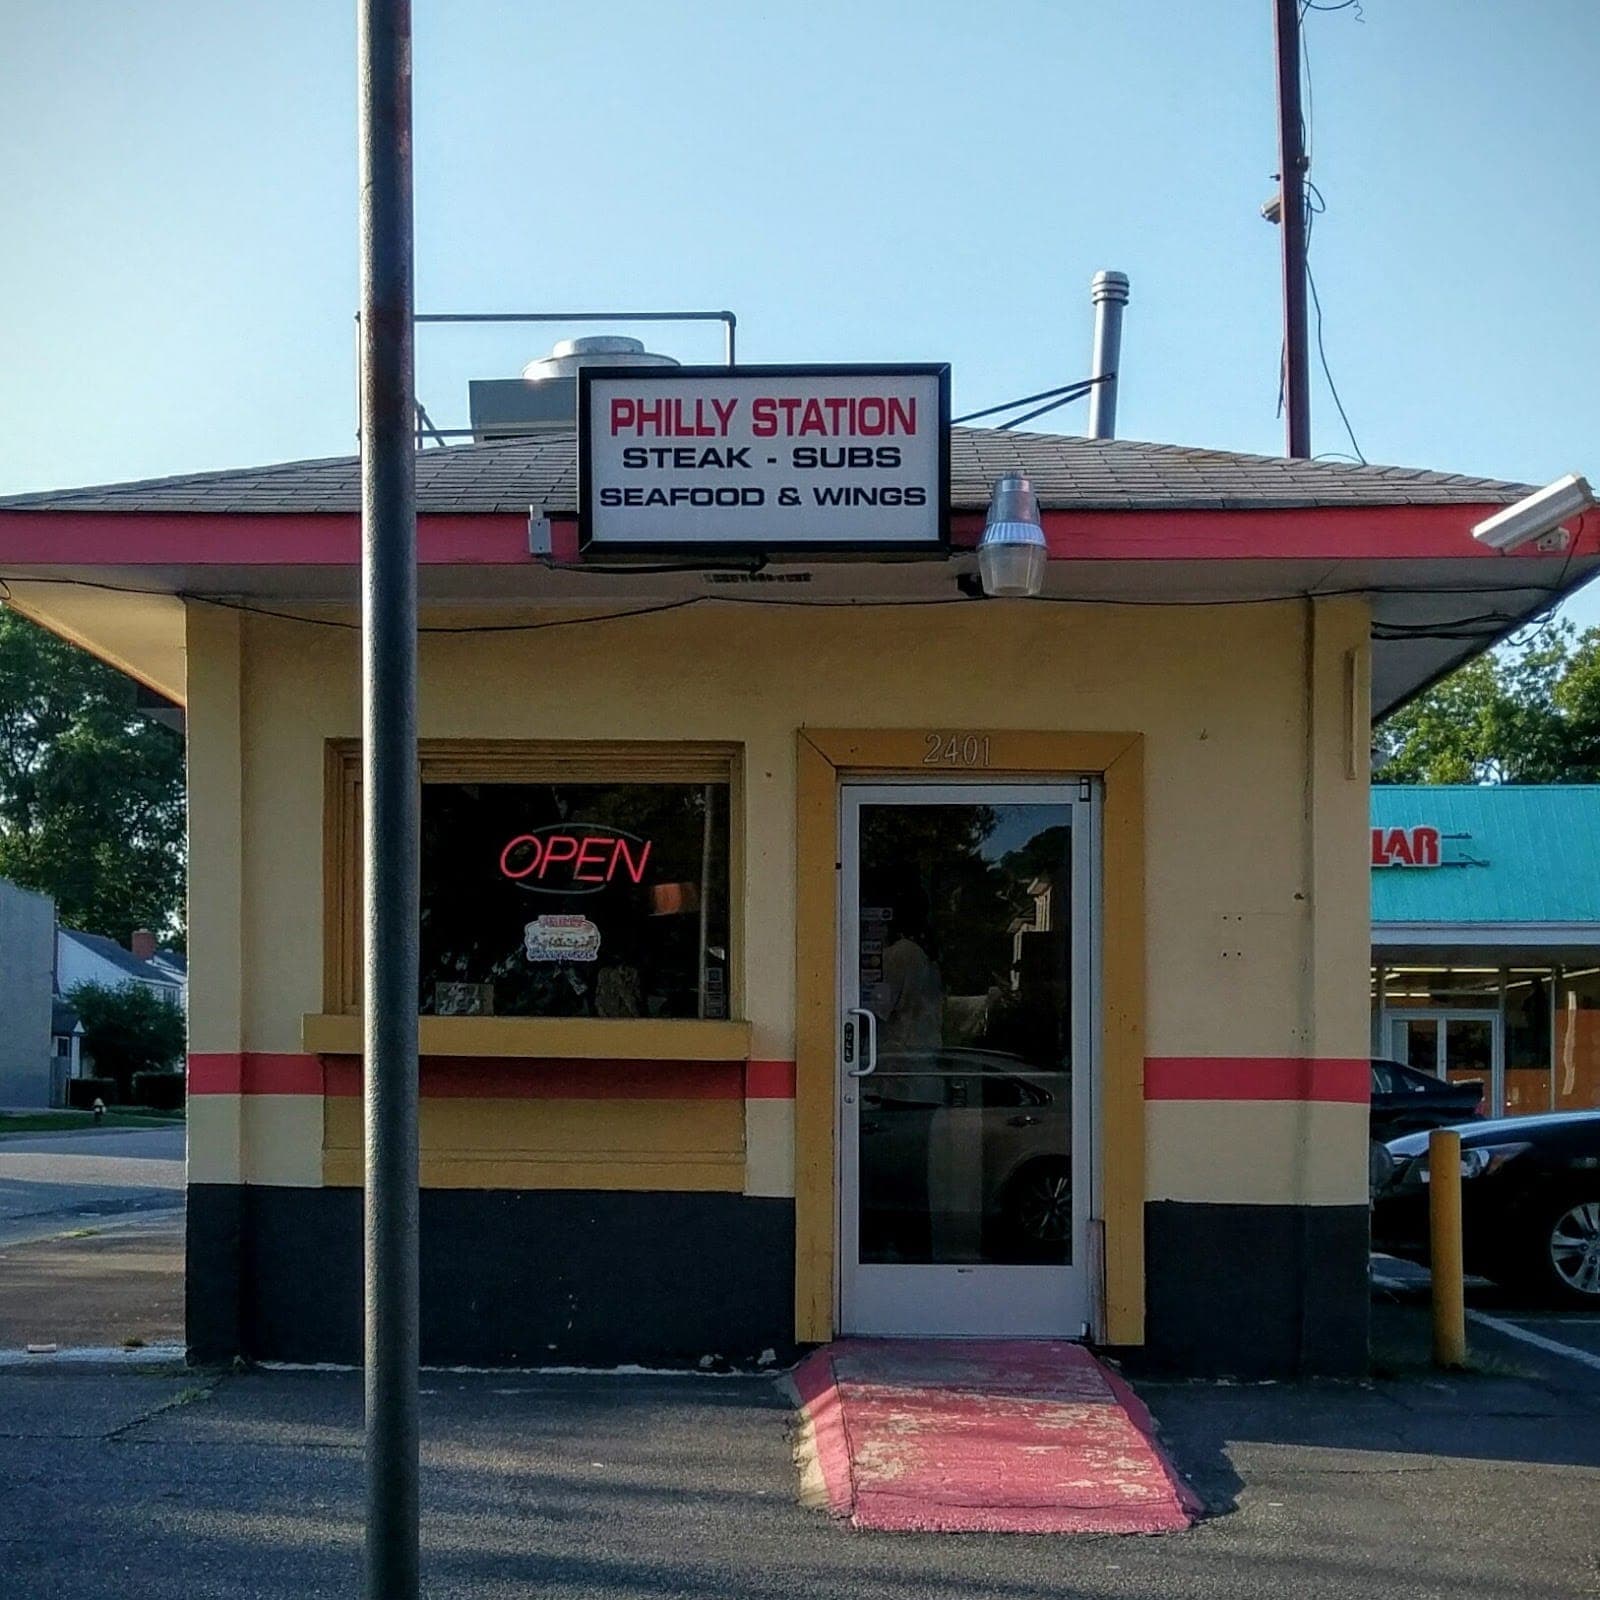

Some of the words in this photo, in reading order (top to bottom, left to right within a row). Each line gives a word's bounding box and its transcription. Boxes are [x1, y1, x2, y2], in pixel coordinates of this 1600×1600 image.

[610, 397, 738, 437] PHILLY
[752, 396, 917, 438] STATION
[622, 446, 752, 469] STEAK
[792, 446, 902, 469] SUBS
[600, 487, 765, 507] SEAFOOD
[777, 487, 803, 506] &
[813, 486, 927, 507] WINGS
[923, 734, 990, 767] 2401
[500, 834, 652, 883] OPEN
